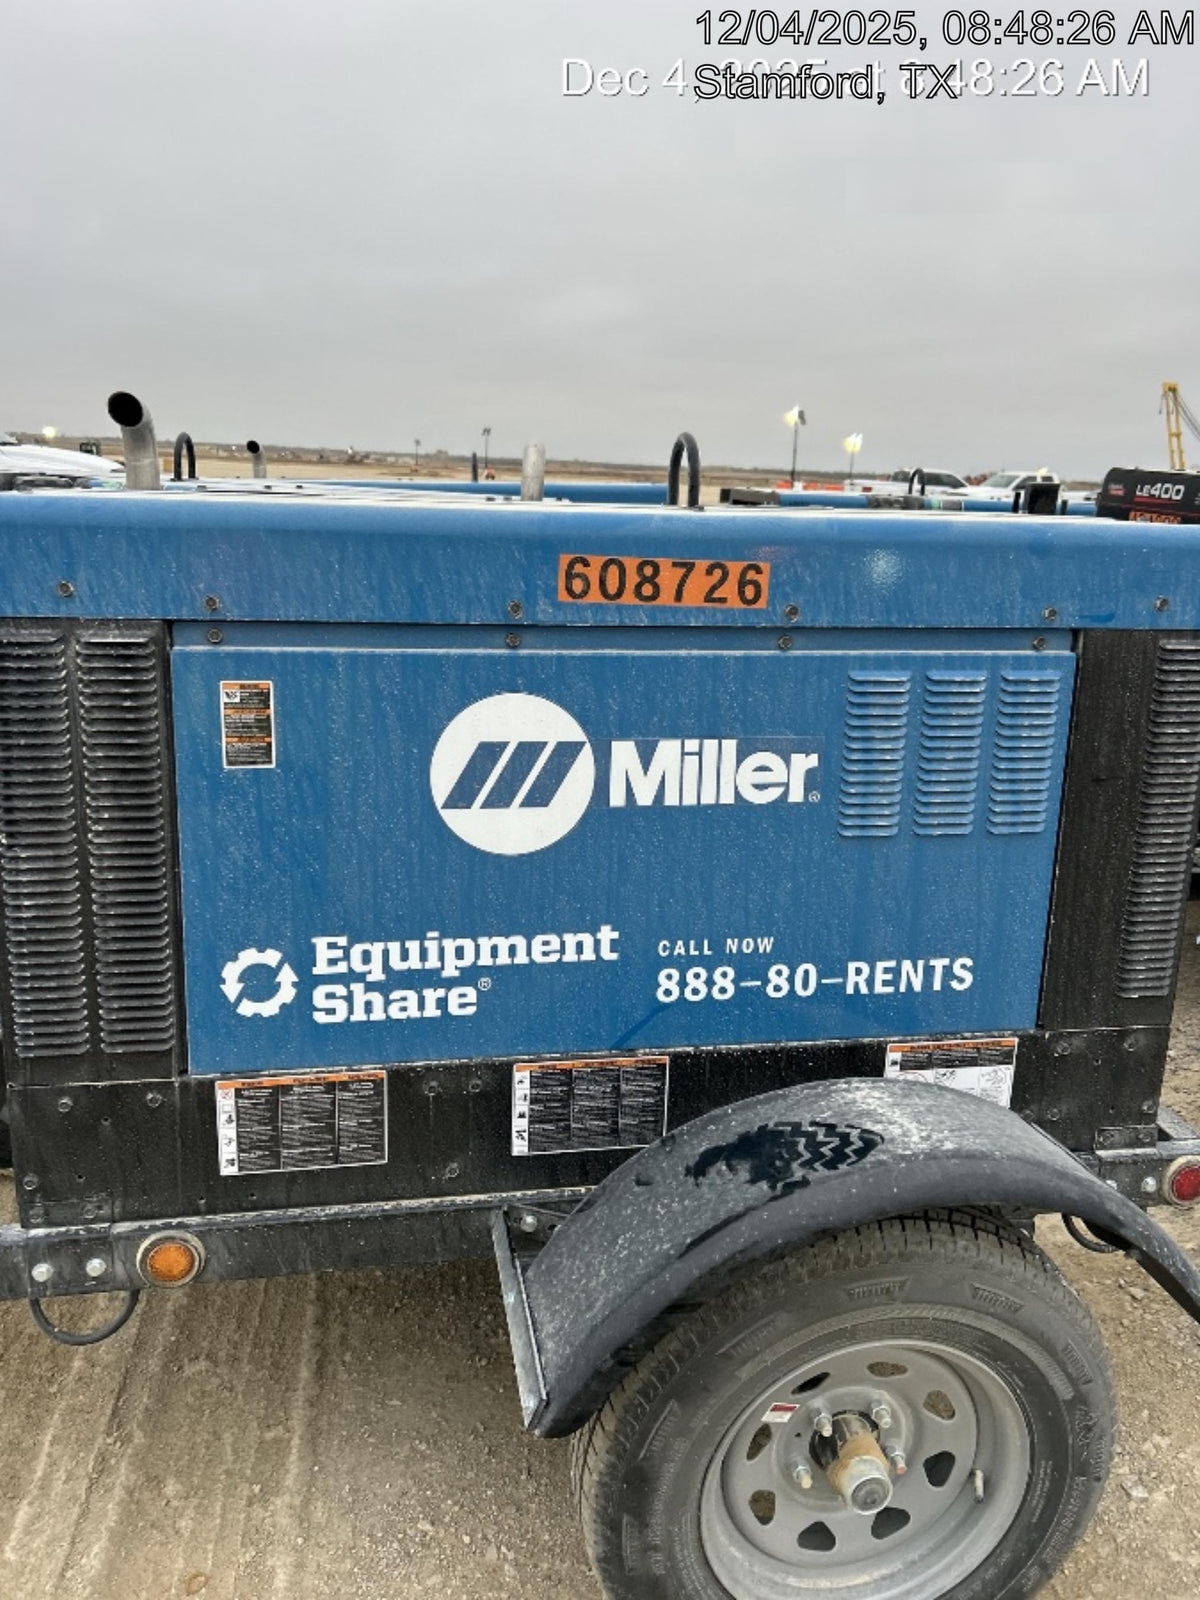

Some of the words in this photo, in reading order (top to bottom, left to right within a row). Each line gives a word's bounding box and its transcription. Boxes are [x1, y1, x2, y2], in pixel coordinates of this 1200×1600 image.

[1135, 482, 1185, 501] LE400
[564, 555, 764, 606] 608726
[311, 925, 619, 982] Equipment
[657, 940, 713, 957] CALL
[725, 936, 775, 954] NOW
